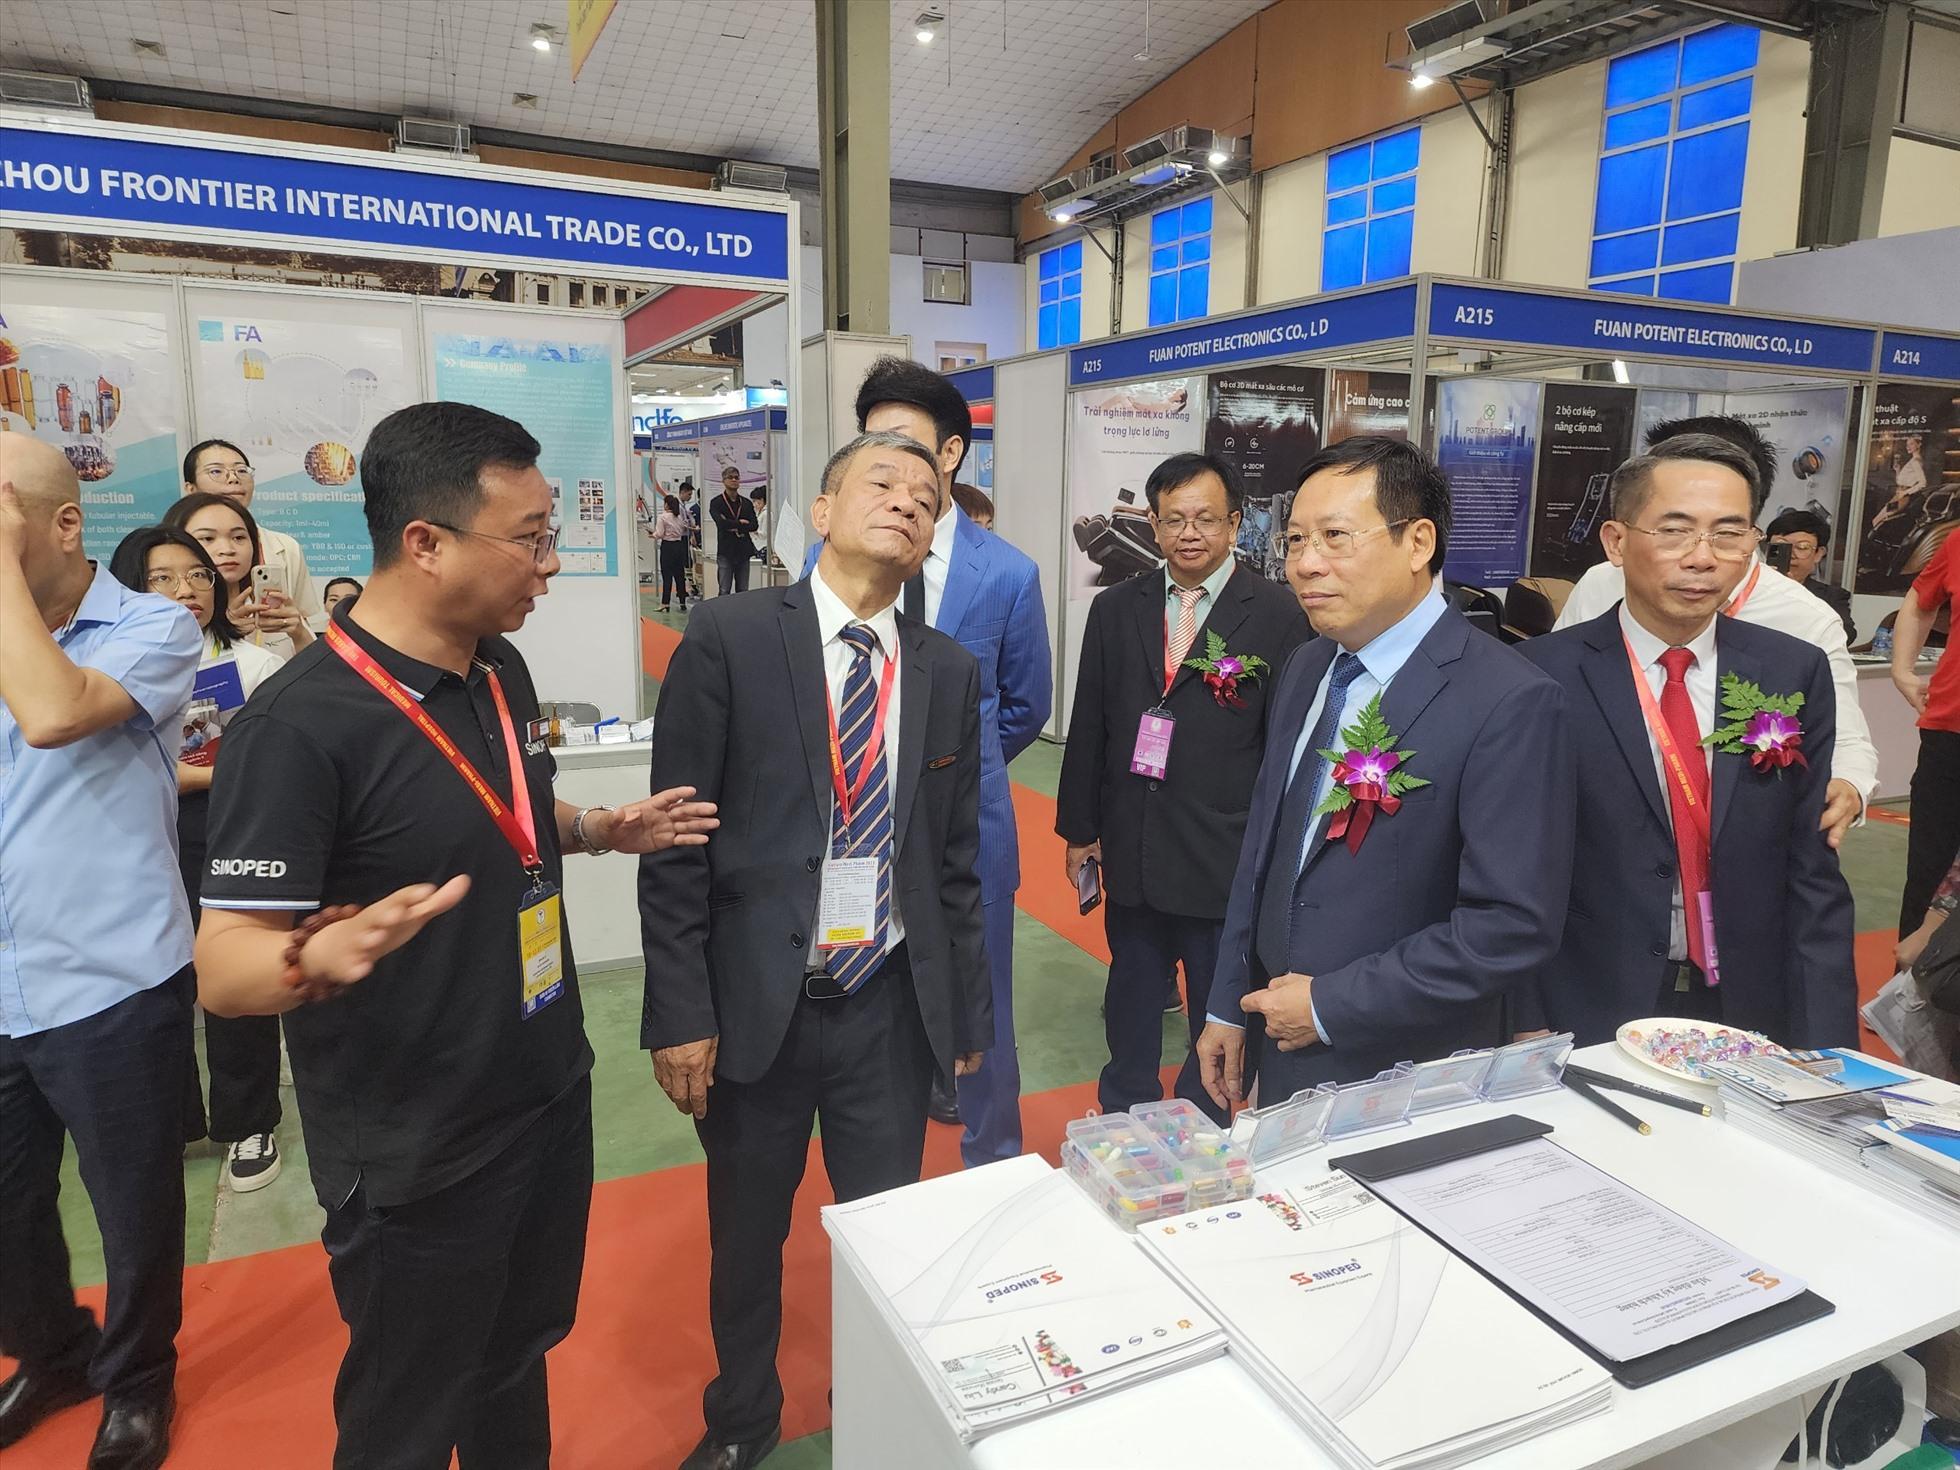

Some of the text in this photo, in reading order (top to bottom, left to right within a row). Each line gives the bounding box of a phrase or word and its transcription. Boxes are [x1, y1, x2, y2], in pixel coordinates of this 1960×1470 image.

[100, 169, 277, 213] FRONTIER
[285, 187, 542, 239] INTERNATIONAL
[545, 215, 640, 248] TRADE
[647, 226, 699, 257] CO.,
[705, 231, 753, 258] LTD
[1455, 305, 1494, 325] A215
[234, 324, 263, 343] FA
[1593, 319, 1632, 339] FUAN
[1633, 325, 1686, 344] POTENT
[1687, 328, 1769, 352] ELECTRONICS
[1770, 336, 1793, 354] CO.,
[1148, 346, 1174, 363] FUAN
[1174, 340, 1212, 359] POTENT
[1213, 328, 1284, 353] ELECTRONICS
[1285, 324, 1309, 340] CO.,
[1082, 360, 1102, 374] A215
[1893, 350, 1921, 366] A214
[1236, 381, 1245, 389] 3D
[1367, 393, 1385, 410] ứng
[1386, 398, 1404, 408] cao
[1875, 403, 1899, 414] thuật
[1083, 405, 1190, 422] Trải nghiệm mát xa không
[1555, 405, 1561, 415] 2
[1561, 405, 1572, 418] bộ
[1582, 406, 1597, 419] kép
[1758, 411, 1769, 419] 2D
[1890, 415, 1907, 426] cấp
[1907, 415, 1920, 426] độ
[1920, 415, 1928, 424] S
[1103, 426, 1127, 438] trọng
[1128, 426, 1141, 439] lực
[1142, 426, 1151, 436] lơ
[1554, 421, 1603, 434] nâng cấp mới
[364, 665, 413, 710] MEDICAL TOURISM
[416, 713, 456, 758] VIETNAM HOSPITAL
[482, 792, 502, 817] VIETNAM
[210, 859, 287, 879] SINOPED
[1716, 1067, 1788, 1101] 2022
[1312, 1260, 1362, 1283] SINOPED
[985, 1276, 1040, 1300] SINOPED
